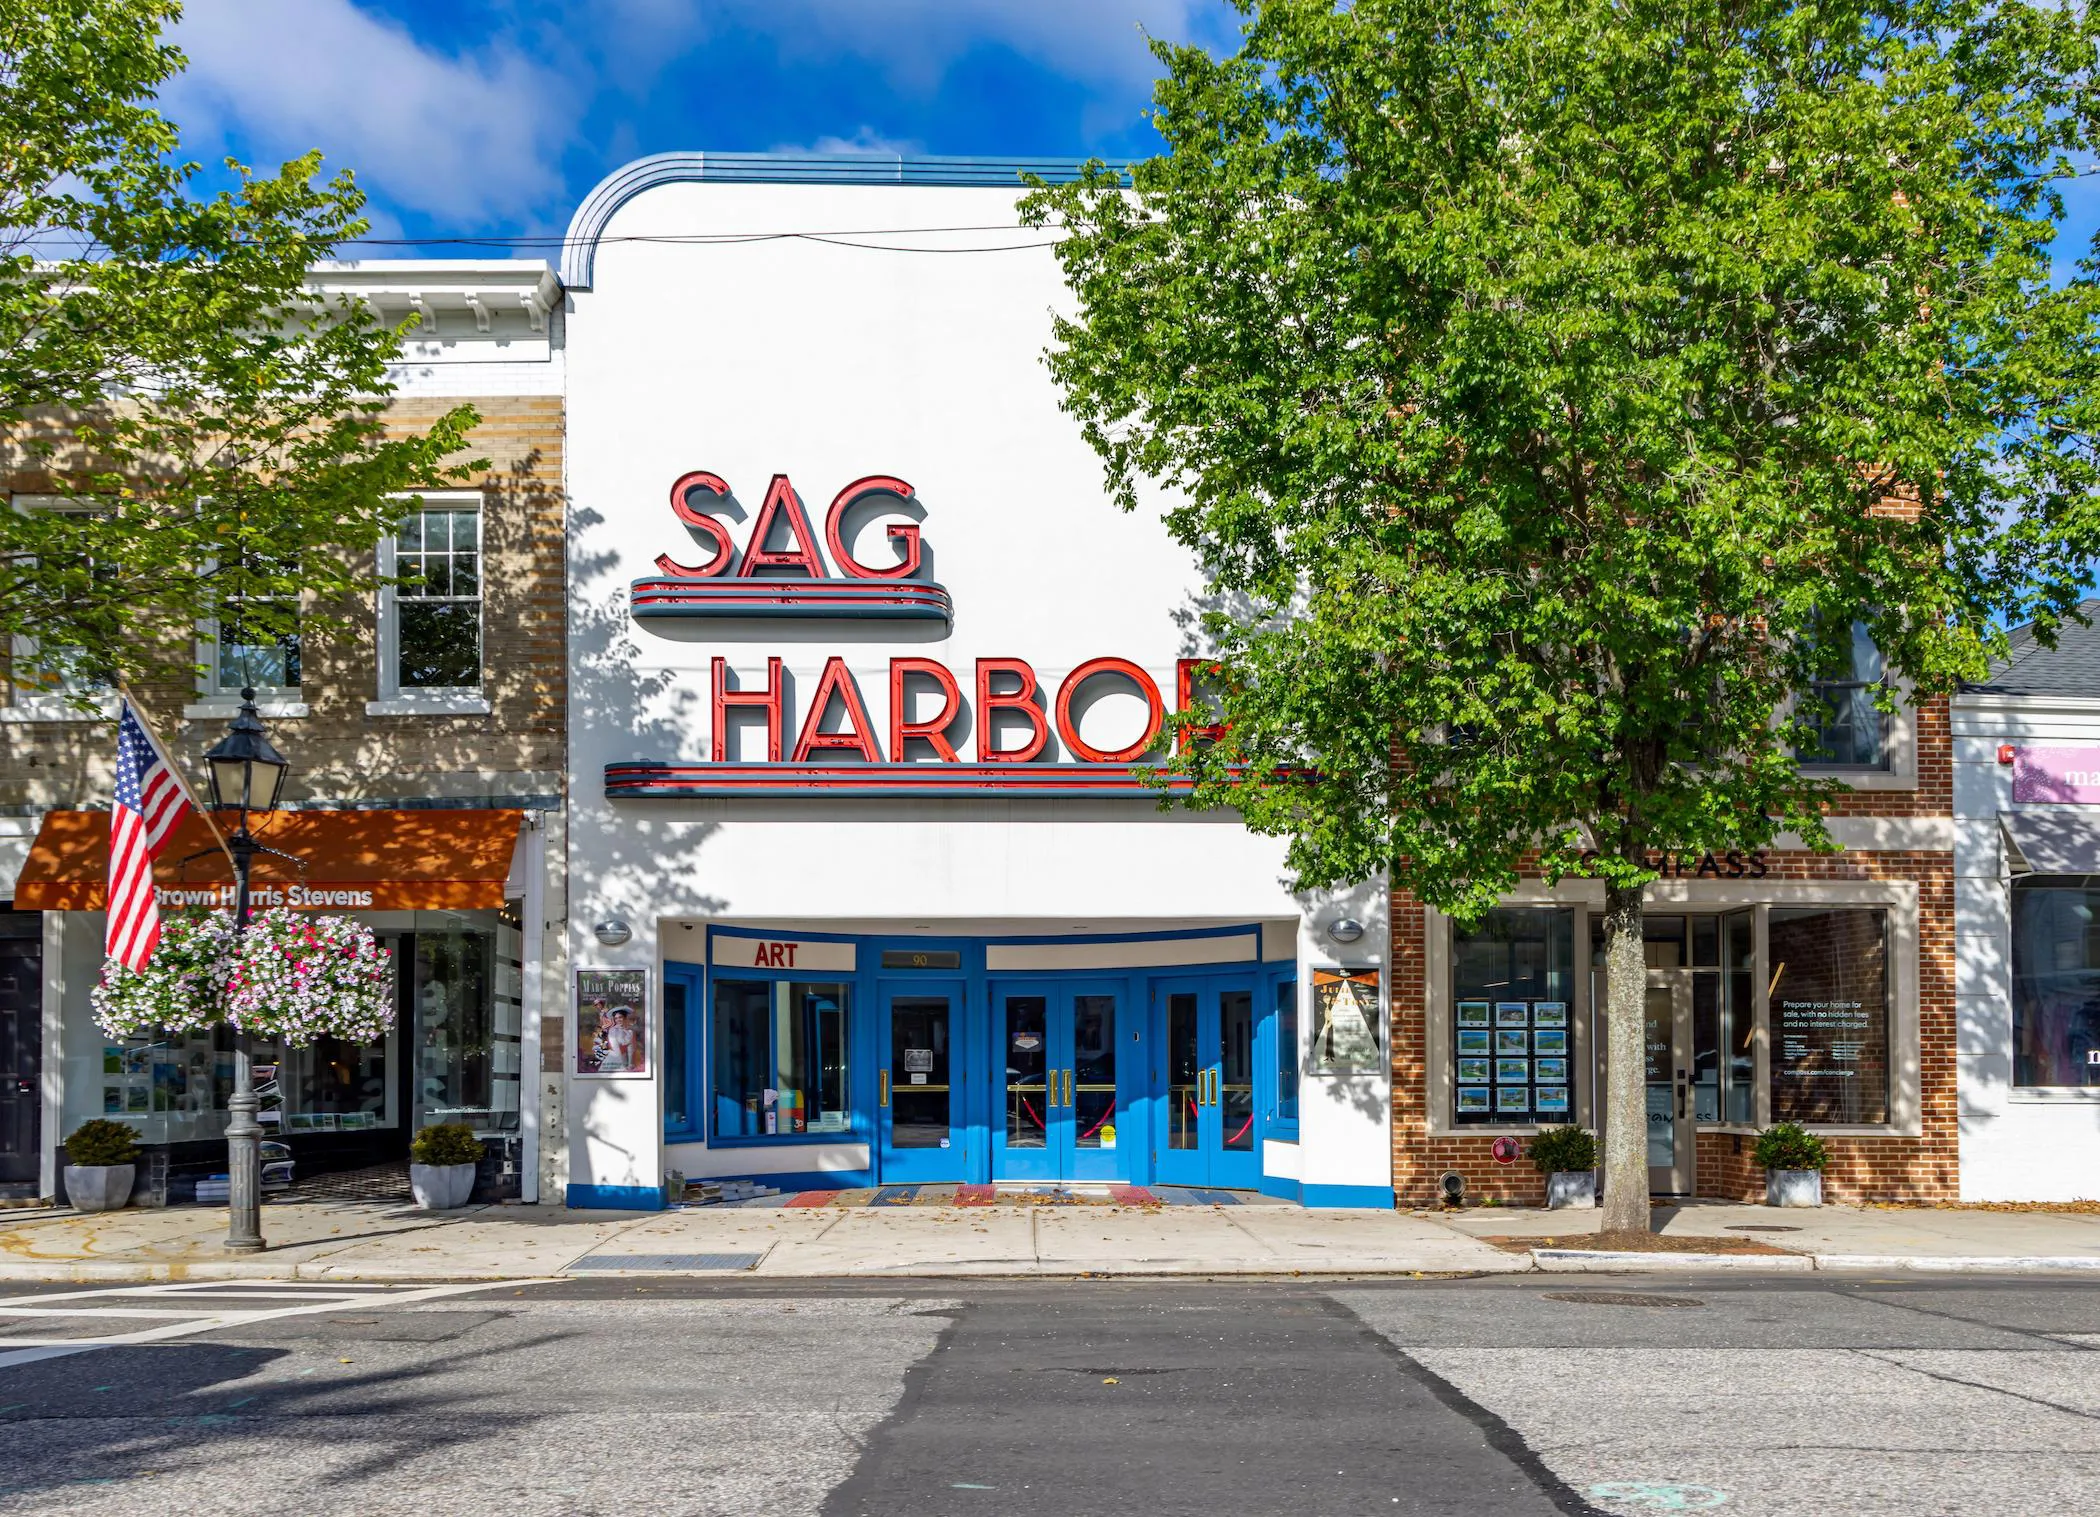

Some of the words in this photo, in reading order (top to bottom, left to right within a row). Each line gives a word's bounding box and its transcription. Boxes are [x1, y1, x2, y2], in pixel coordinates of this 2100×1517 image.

[654, 471, 922, 578] SAG
[153, 886, 215, 905] Brown
[221, 886, 283, 905] Hrris
[288, 886, 372, 905] Stevens
[754, 942, 798, 968] ART
[912, 954, 928, 966] 90
[1783, 1001, 1812, 1009] Prepare
[1646, 1042, 1667, 1050] with
